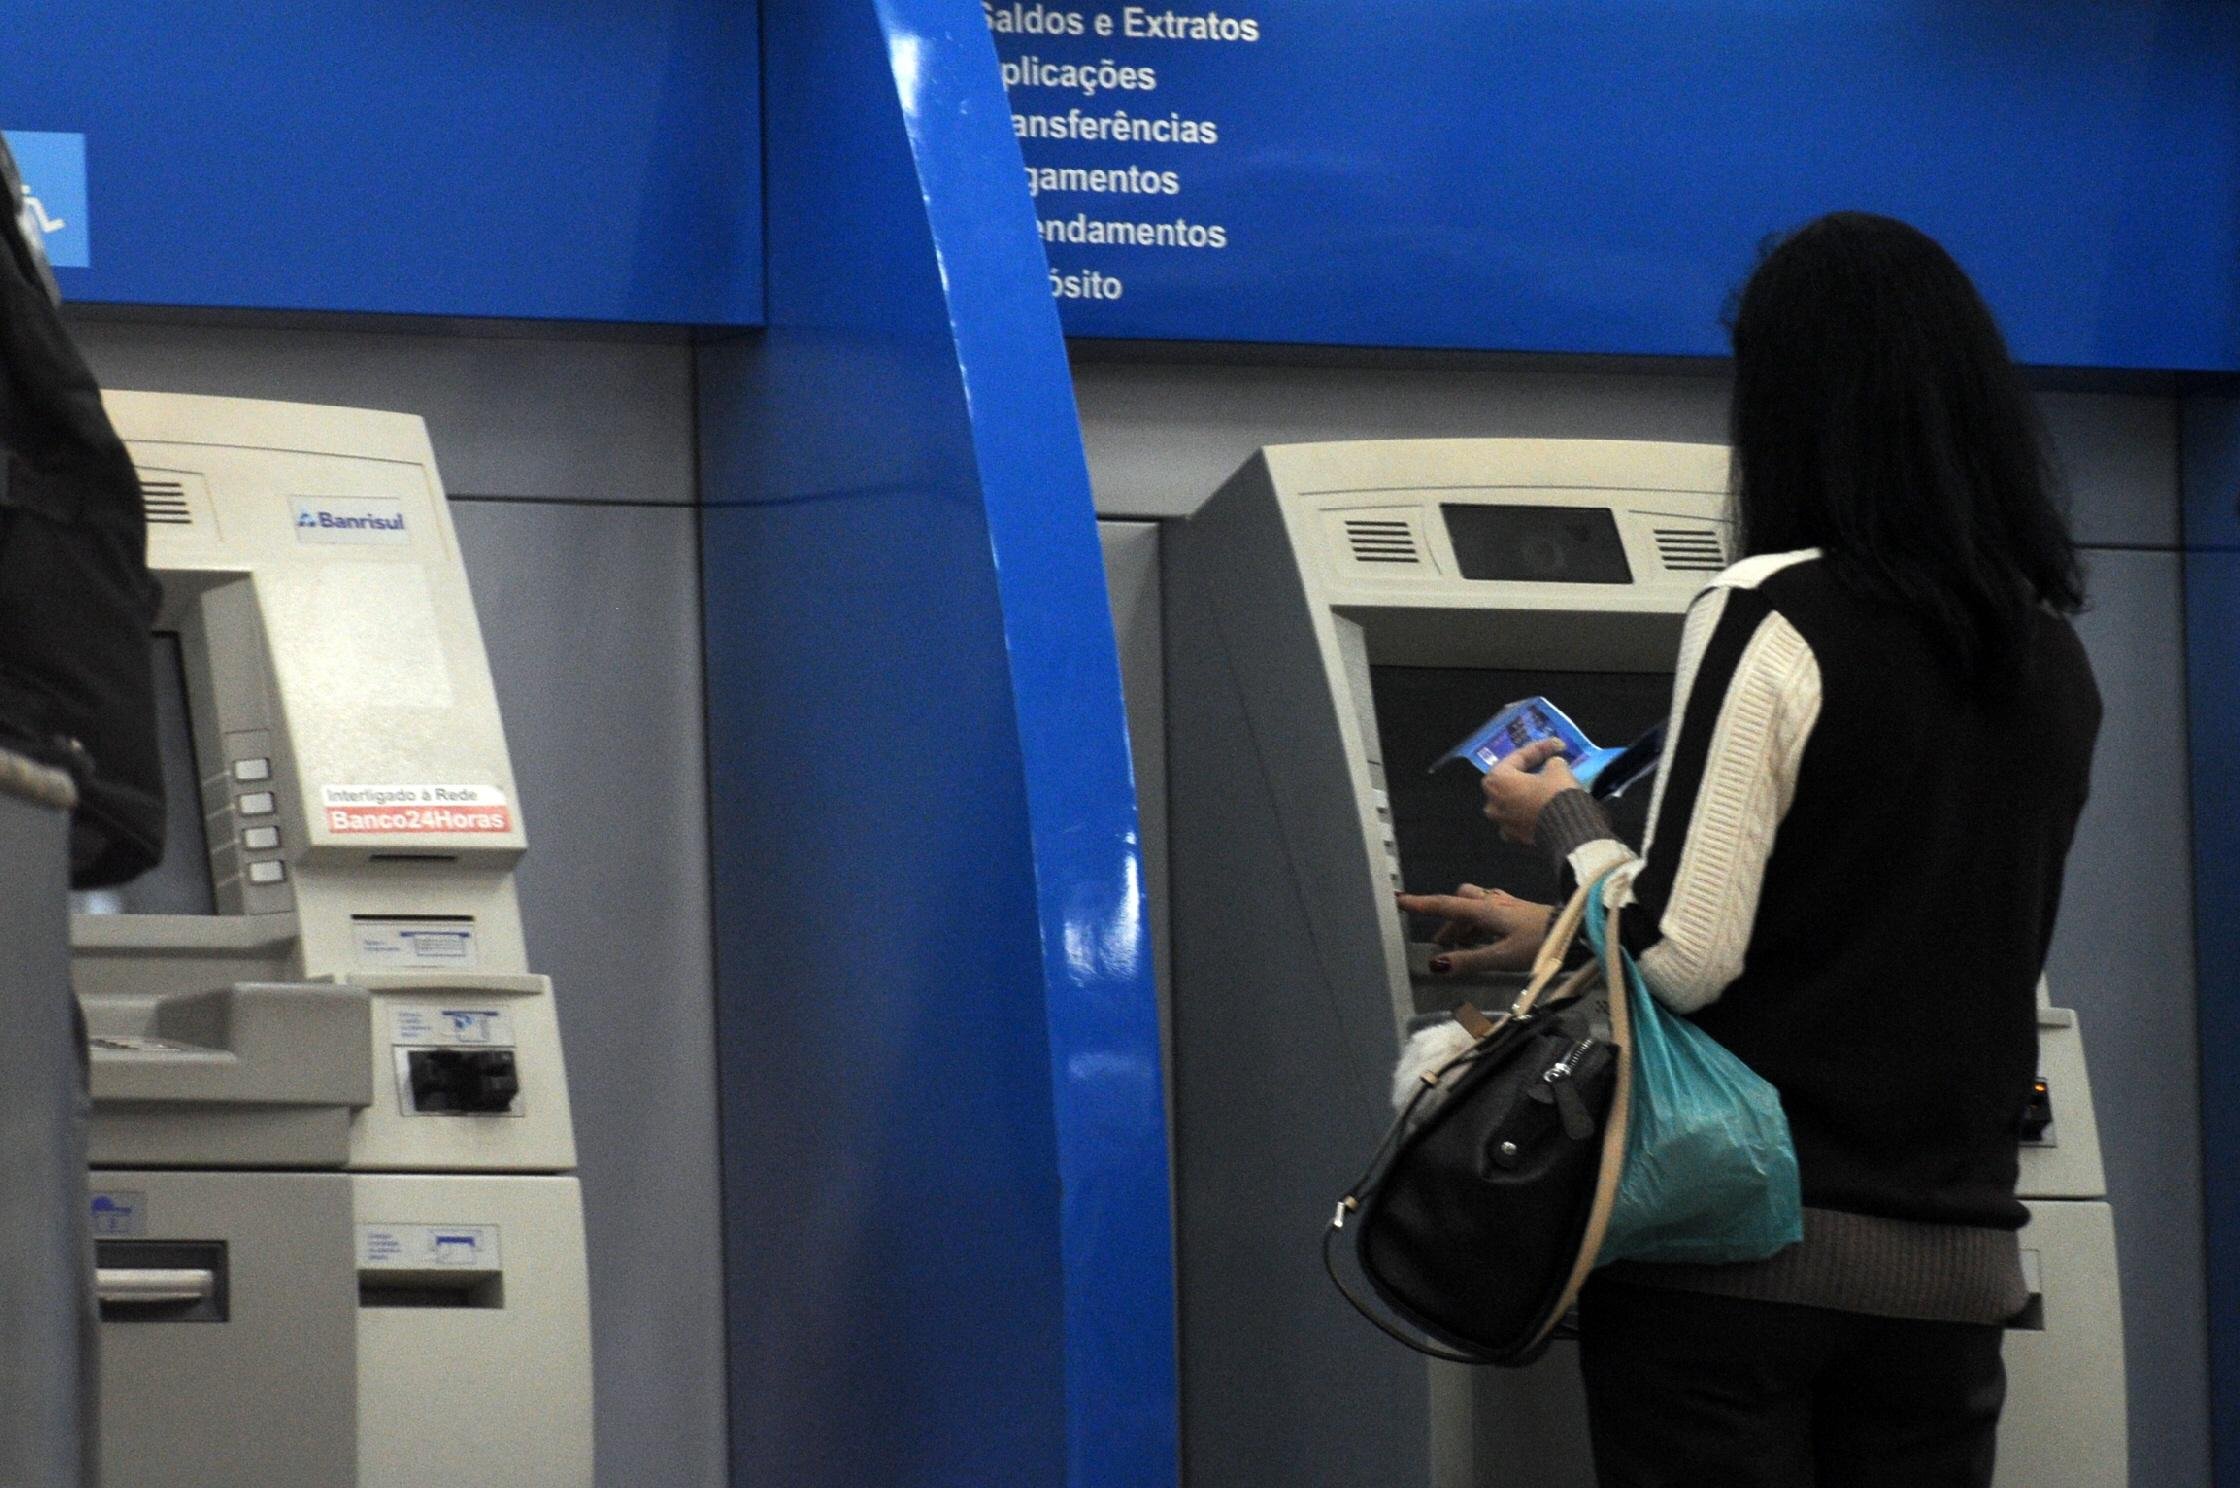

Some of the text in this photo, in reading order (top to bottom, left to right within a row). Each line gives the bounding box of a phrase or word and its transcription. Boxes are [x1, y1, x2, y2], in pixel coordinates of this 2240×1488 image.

[1094, 14, 1113, 36] e
[1123, 6, 1260, 42] Extratos
[1001, 55, 1156, 96] plicações
[1011, 108, 1218, 144] ansferências
[1024, 165, 1179, 197] gamentos
[1036, 213, 1227, 248] ndamentos
[1048, 268, 1122, 300] ósito
[318, 511, 404, 530] Banrisul
[327, 787, 416, 804] Interligado
[435, 787, 478, 801] Rede
[331, 810, 505, 830] Banco24Horas
